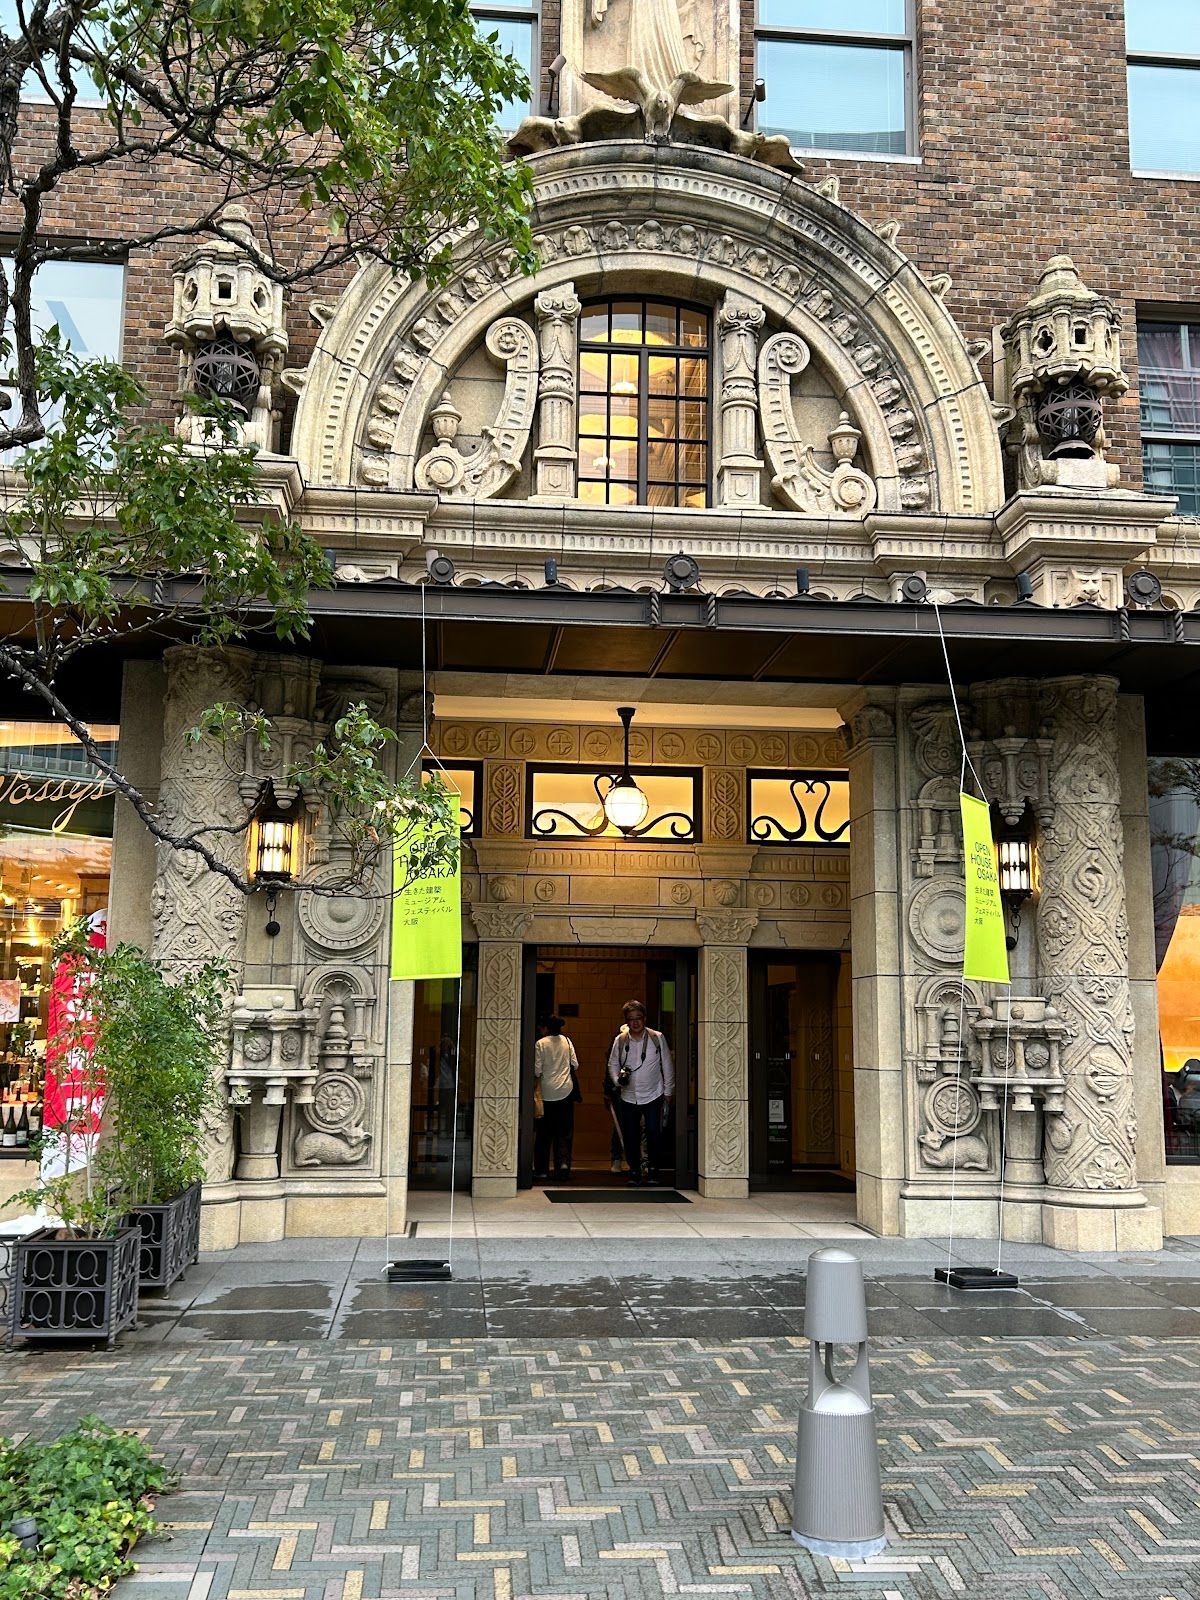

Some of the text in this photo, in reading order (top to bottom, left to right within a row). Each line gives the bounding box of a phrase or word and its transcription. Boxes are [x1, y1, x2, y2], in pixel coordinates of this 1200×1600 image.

[975, 841, 991, 857] OPEN
[971, 853, 993, 870] HOUSE
[977, 868, 998, 883] OSAKA
[404, 886, 442, 896] 生きた建築
[404, 897, 446, 906] ミュージアム
[975, 897, 997, 907] ミュージアム
[404, 906, 453, 916] フェスティバル
[975, 907, 1001, 918] フェスティバル
[403, 918, 419, 926] 大阪
